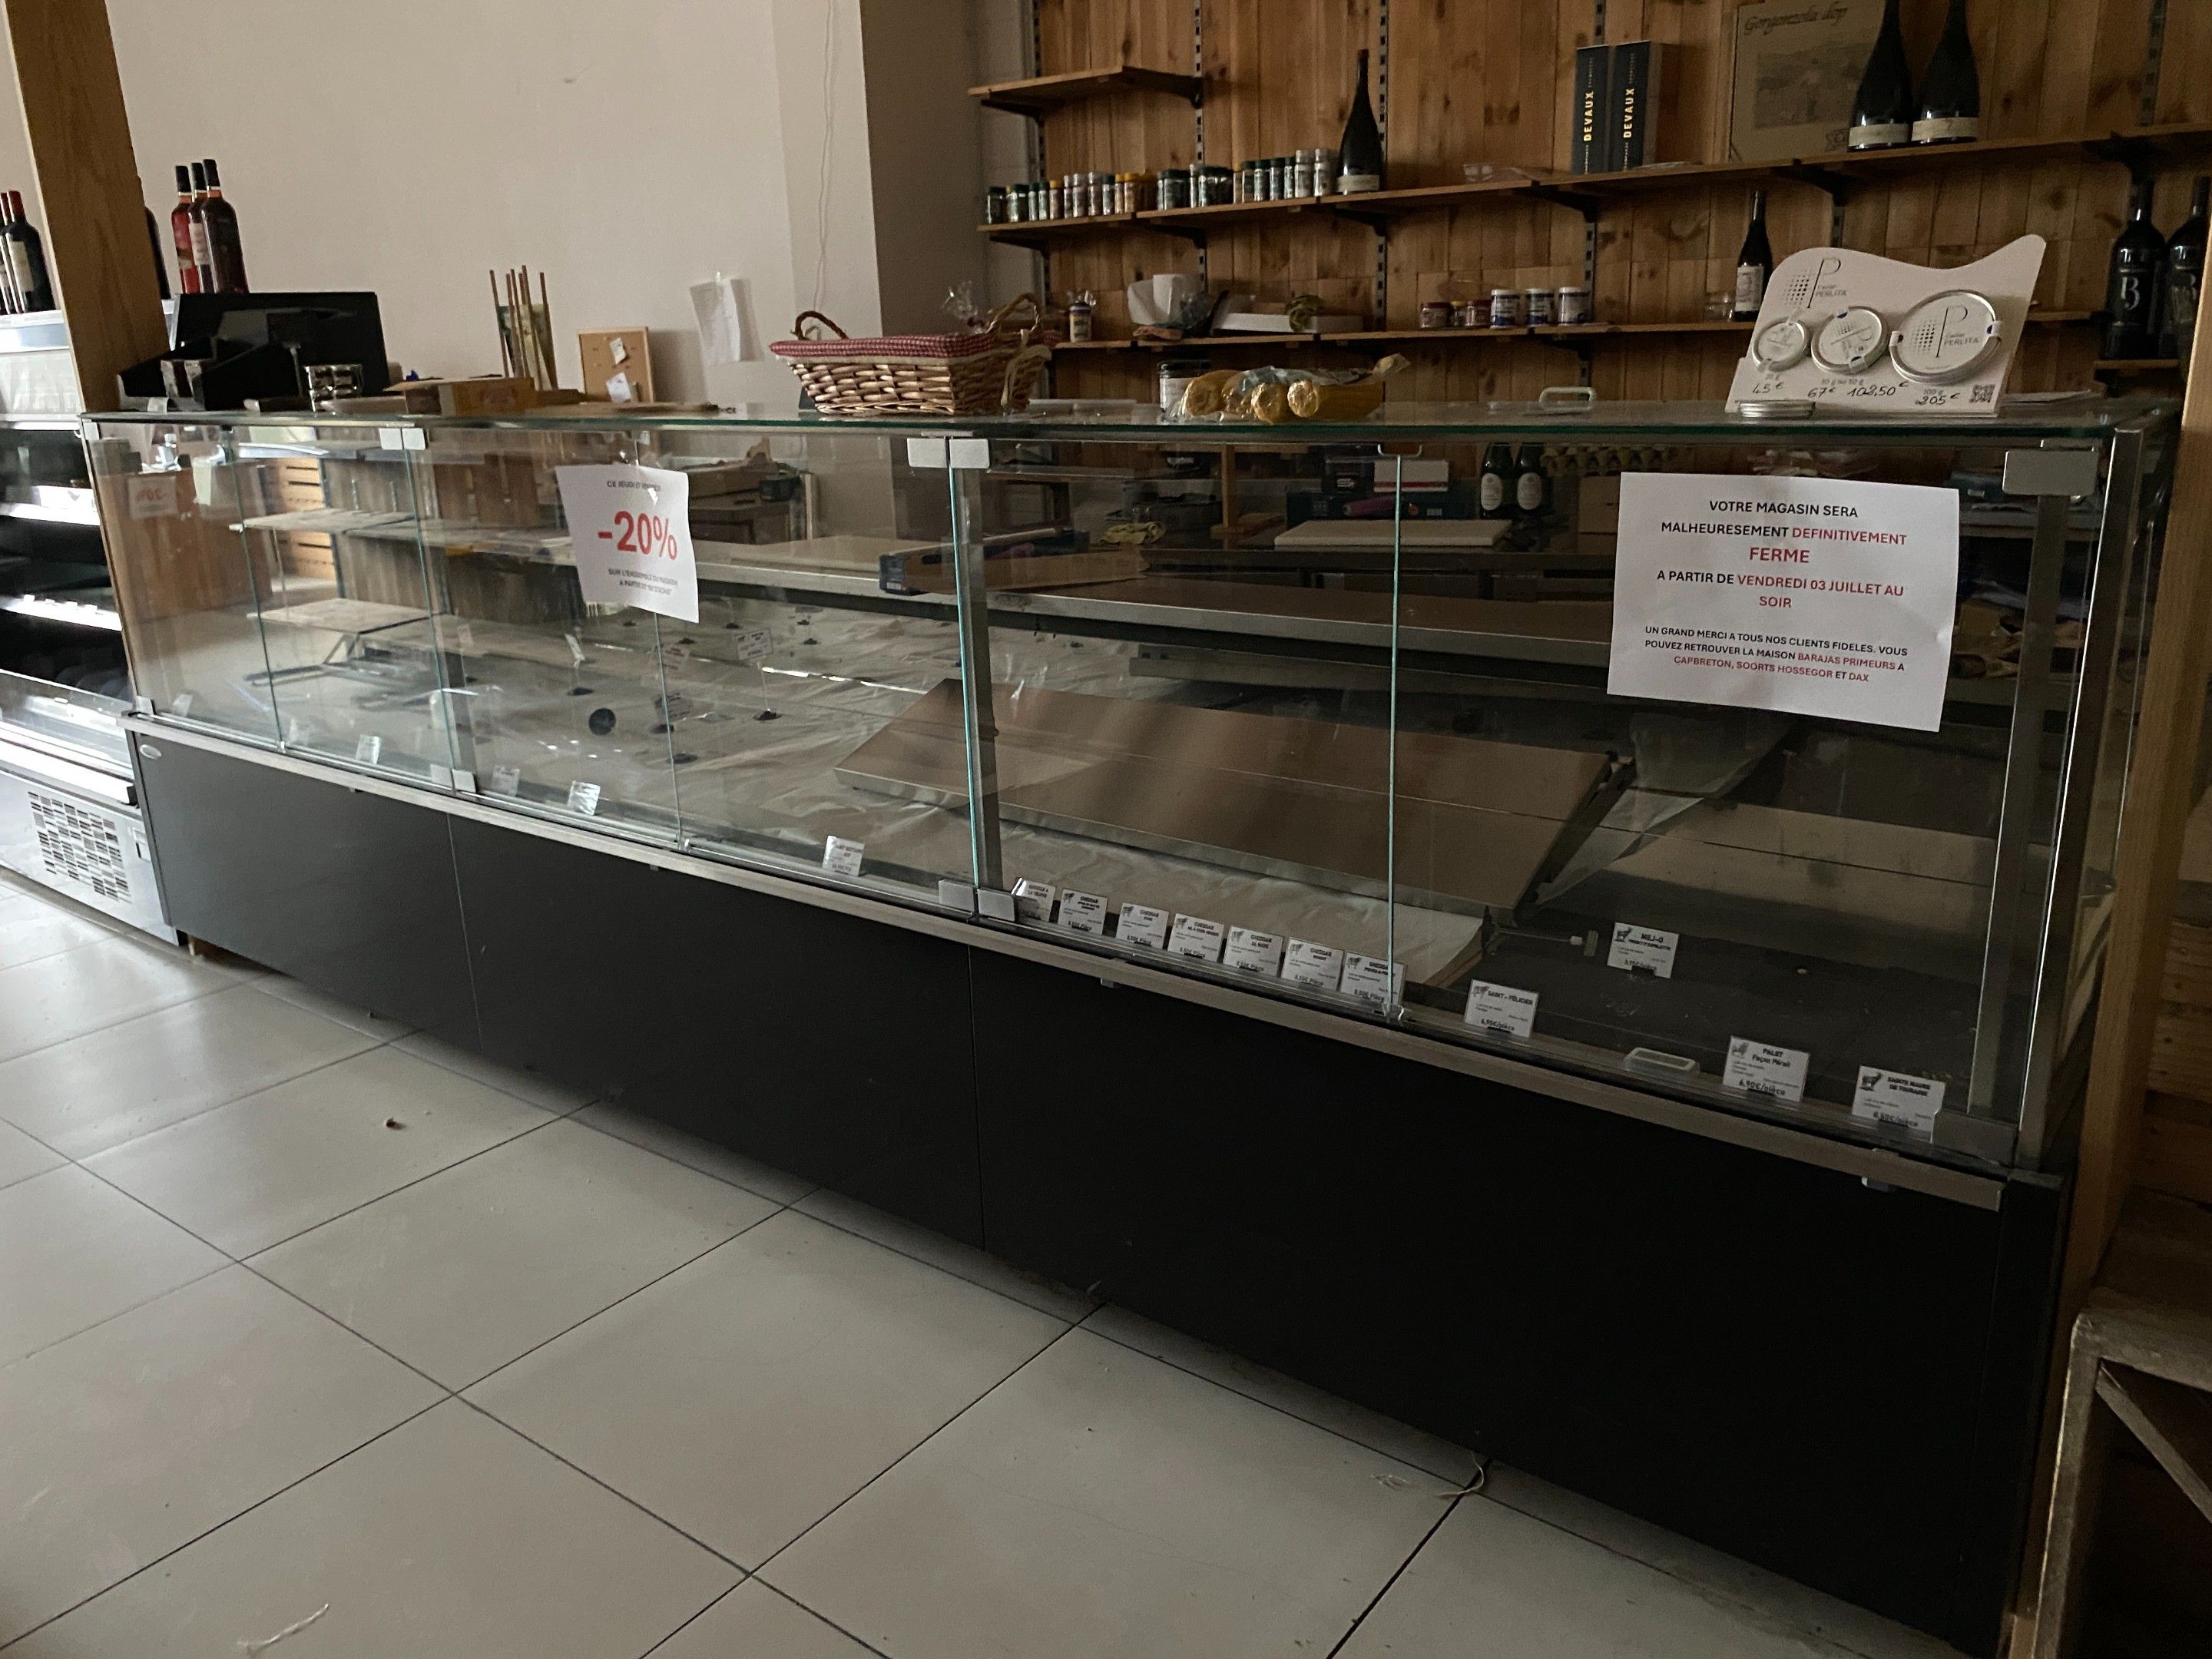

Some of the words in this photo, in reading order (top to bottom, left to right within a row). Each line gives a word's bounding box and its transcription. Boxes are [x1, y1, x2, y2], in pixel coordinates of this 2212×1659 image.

[1584, 91, 1594, 141] DEVAUX
[1624, 88, 1634, 138] DEVAUX
[1943, 338, 1979, 346] PERLITA
[1709, 500, 1753, 513] VOTRE
[1757, 502, 1820, 516] MAGASIN
[1823, 505, 1858, 518] SERA
[598, 511, 677, 561] -20%
[1661, 522, 1789, 538] MALHEURESEMENT
[1792, 527, 1907, 545] DEFINITIVEMENT
[1749, 547, 1810, 564] FERME
[1657, 571, 1665, 581] A
[1668, 571, 1713, 583] PARTIR
[1717, 572, 1734, 584] DE
[1737, 575, 1806, 589] VENDREDI
[1810, 578, 1826, 591] 03
[1828, 580, 1882, 595] JUILLET
[1884, 584, 1904, 597] AU
[1759, 596, 1792, 608] SOIR
[1645, 626, 1659, 635] UN
[1661, 627, 1695, 637] GRAND
[1697, 629, 1727, 640] MERCI
[1729, 631, 1736, 641] A
[1737, 632, 1763, 644] TOUS
[1765, 634, 1786, 645] NOS
[1789, 636, 1830, 650] CLIENTS
[1832, 639, 1876, 654] FIDELES.
[1879, 643, 1908, 657] VOUS
[1645, 639, 1683, 651] POUVEZ
[1684, 641, 1740, 656] RETROUVER
[1743, 646, 1754, 656] LA
[1757, 647, 1796, 660] MAISON
[1797, 652, 1840, 665] BARAJAS
[1843, 656, 1896, 671] PRIMEURS
[1897, 662, 1905, 671] A
[1674, 655, 1734, 670] CAPBRETON,
[1736, 660, 1775, 673] SOORTS
[1777, 664, 1833, 678] HOSSEGOR
[1835, 670, 1846, 679] ET
[1848, 671, 1869, 683] DAX
[1488, 990, 1505, 998] SAINT
[1752, 1053, 1771, 1065] Façon
[1763, 1048, 1783, 1058] PALET
